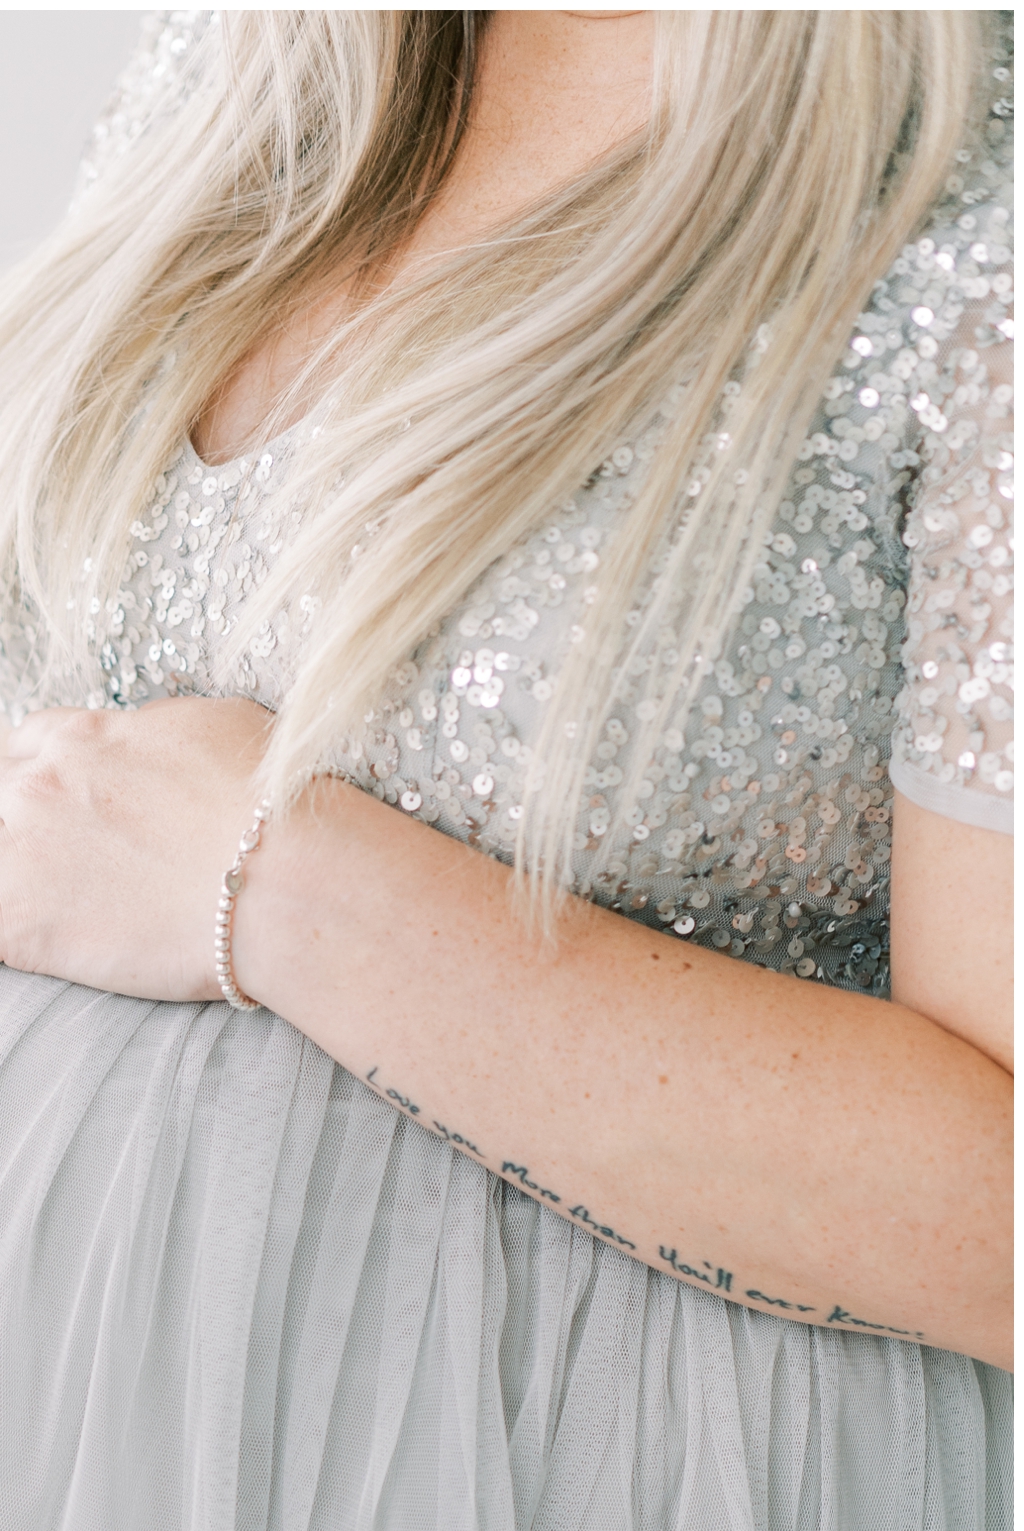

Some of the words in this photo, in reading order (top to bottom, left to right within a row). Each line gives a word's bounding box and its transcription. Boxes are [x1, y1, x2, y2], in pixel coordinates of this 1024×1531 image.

[366, 1066, 420, 1117] Love
[432, 1120, 486, 1159] you
[568, 1205, 636, 1251] than
[745, 1289, 817, 1312] ever
